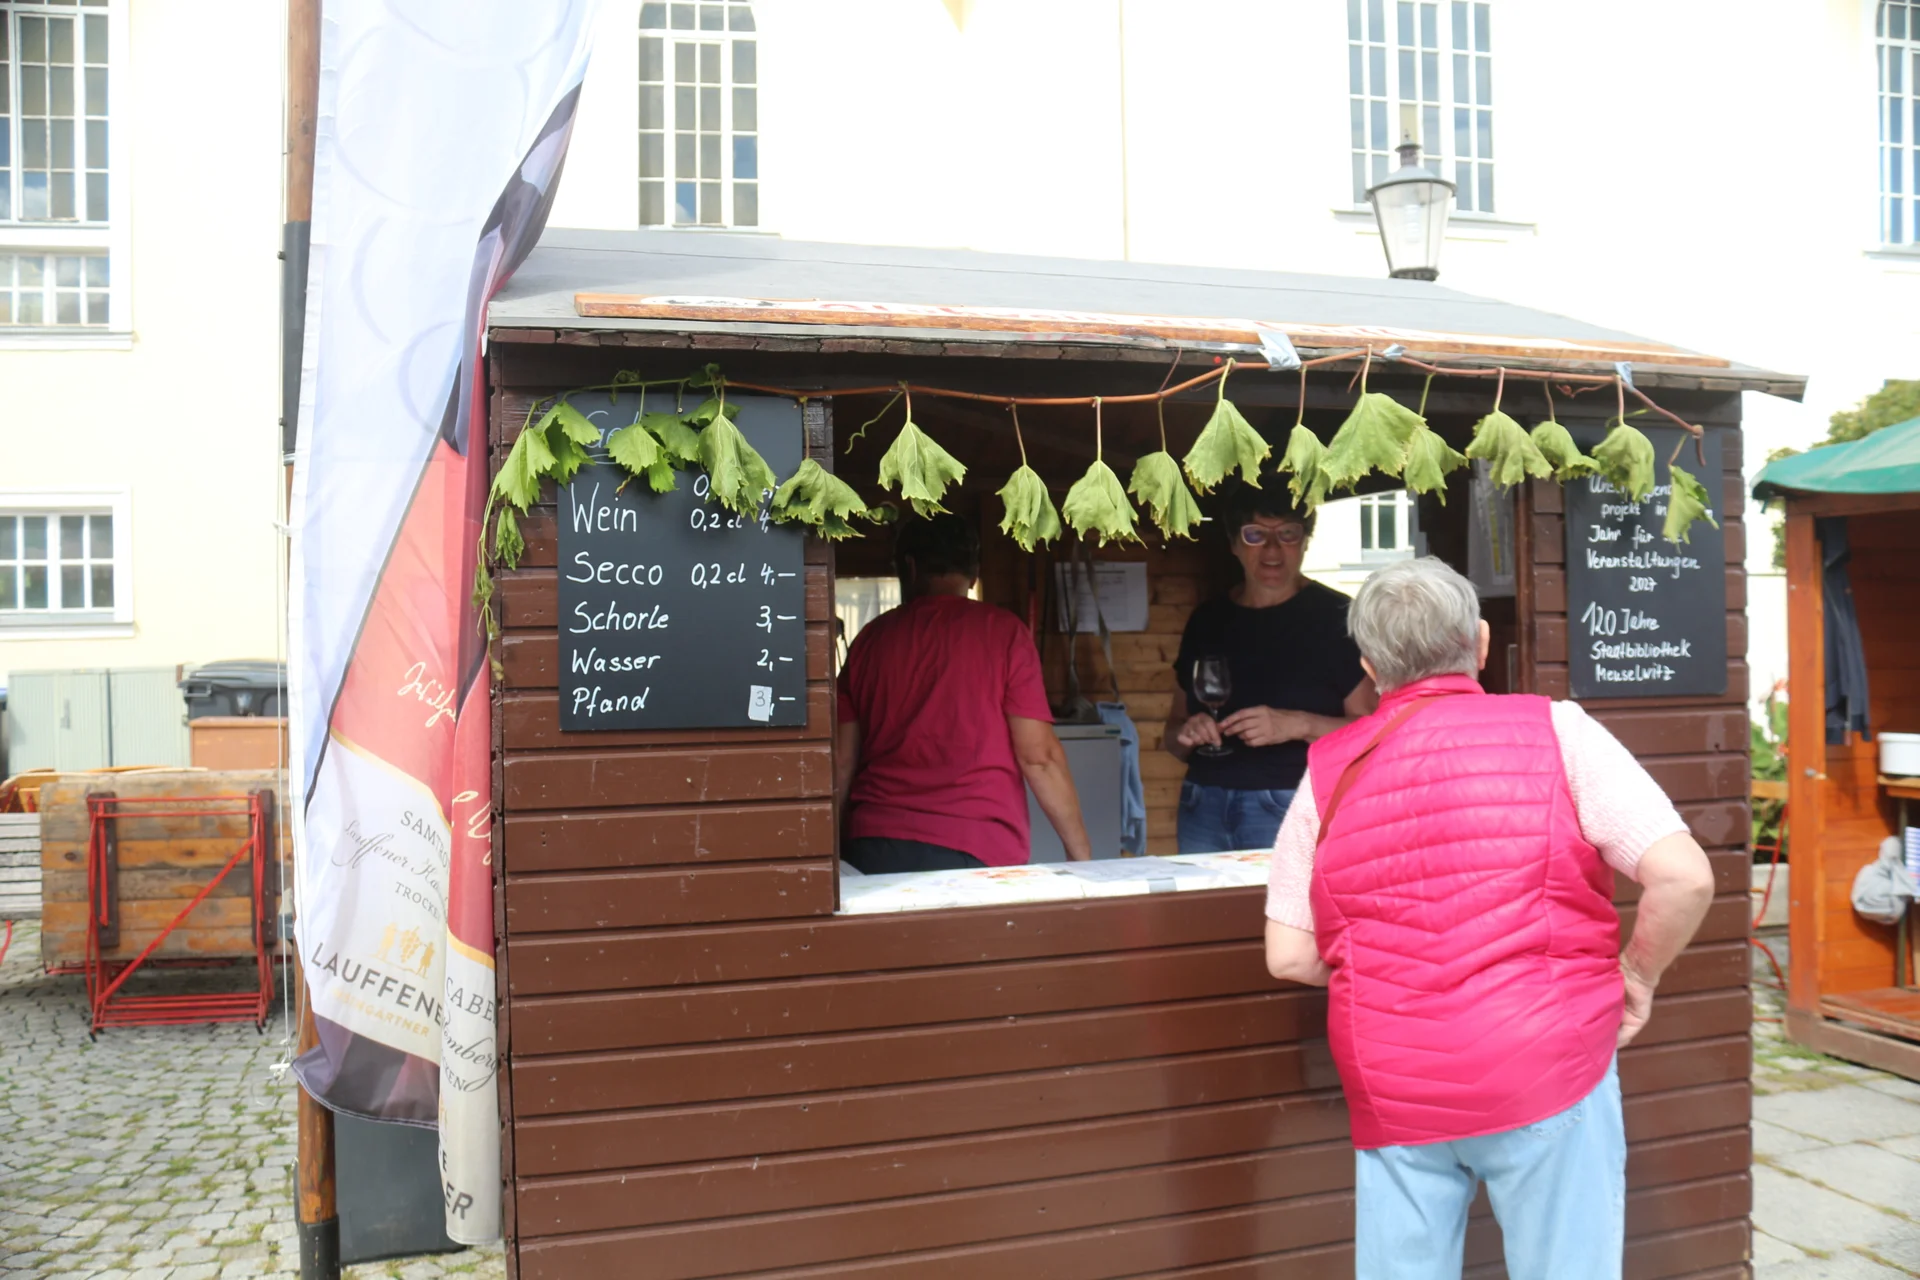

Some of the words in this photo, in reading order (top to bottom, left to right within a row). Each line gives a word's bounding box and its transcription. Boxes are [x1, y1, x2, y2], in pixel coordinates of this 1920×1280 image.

[570, 482, 638, 534] Wein
[1600, 502, 1641, 522] projekt
[1588, 525, 1622, 543] Jahr
[1631, 524, 1655, 550] für
[566, 551, 663, 586] Secco
[691, 563, 721, 590] 0,2
[726, 563, 746, 584] cl
[1586, 547, 1701, 579] Veranstaltungen
[569, 601, 670, 634] Schorle
[1581, 601, 1617, 636] 120
[1619, 607, 1660, 634] Jahre
[571, 647, 662, 675] Wasser
[572, 687, 649, 716] Pfand
[311, 942, 443, 1027] LAUFFENE
[446, 976, 496, 1025] CABE
